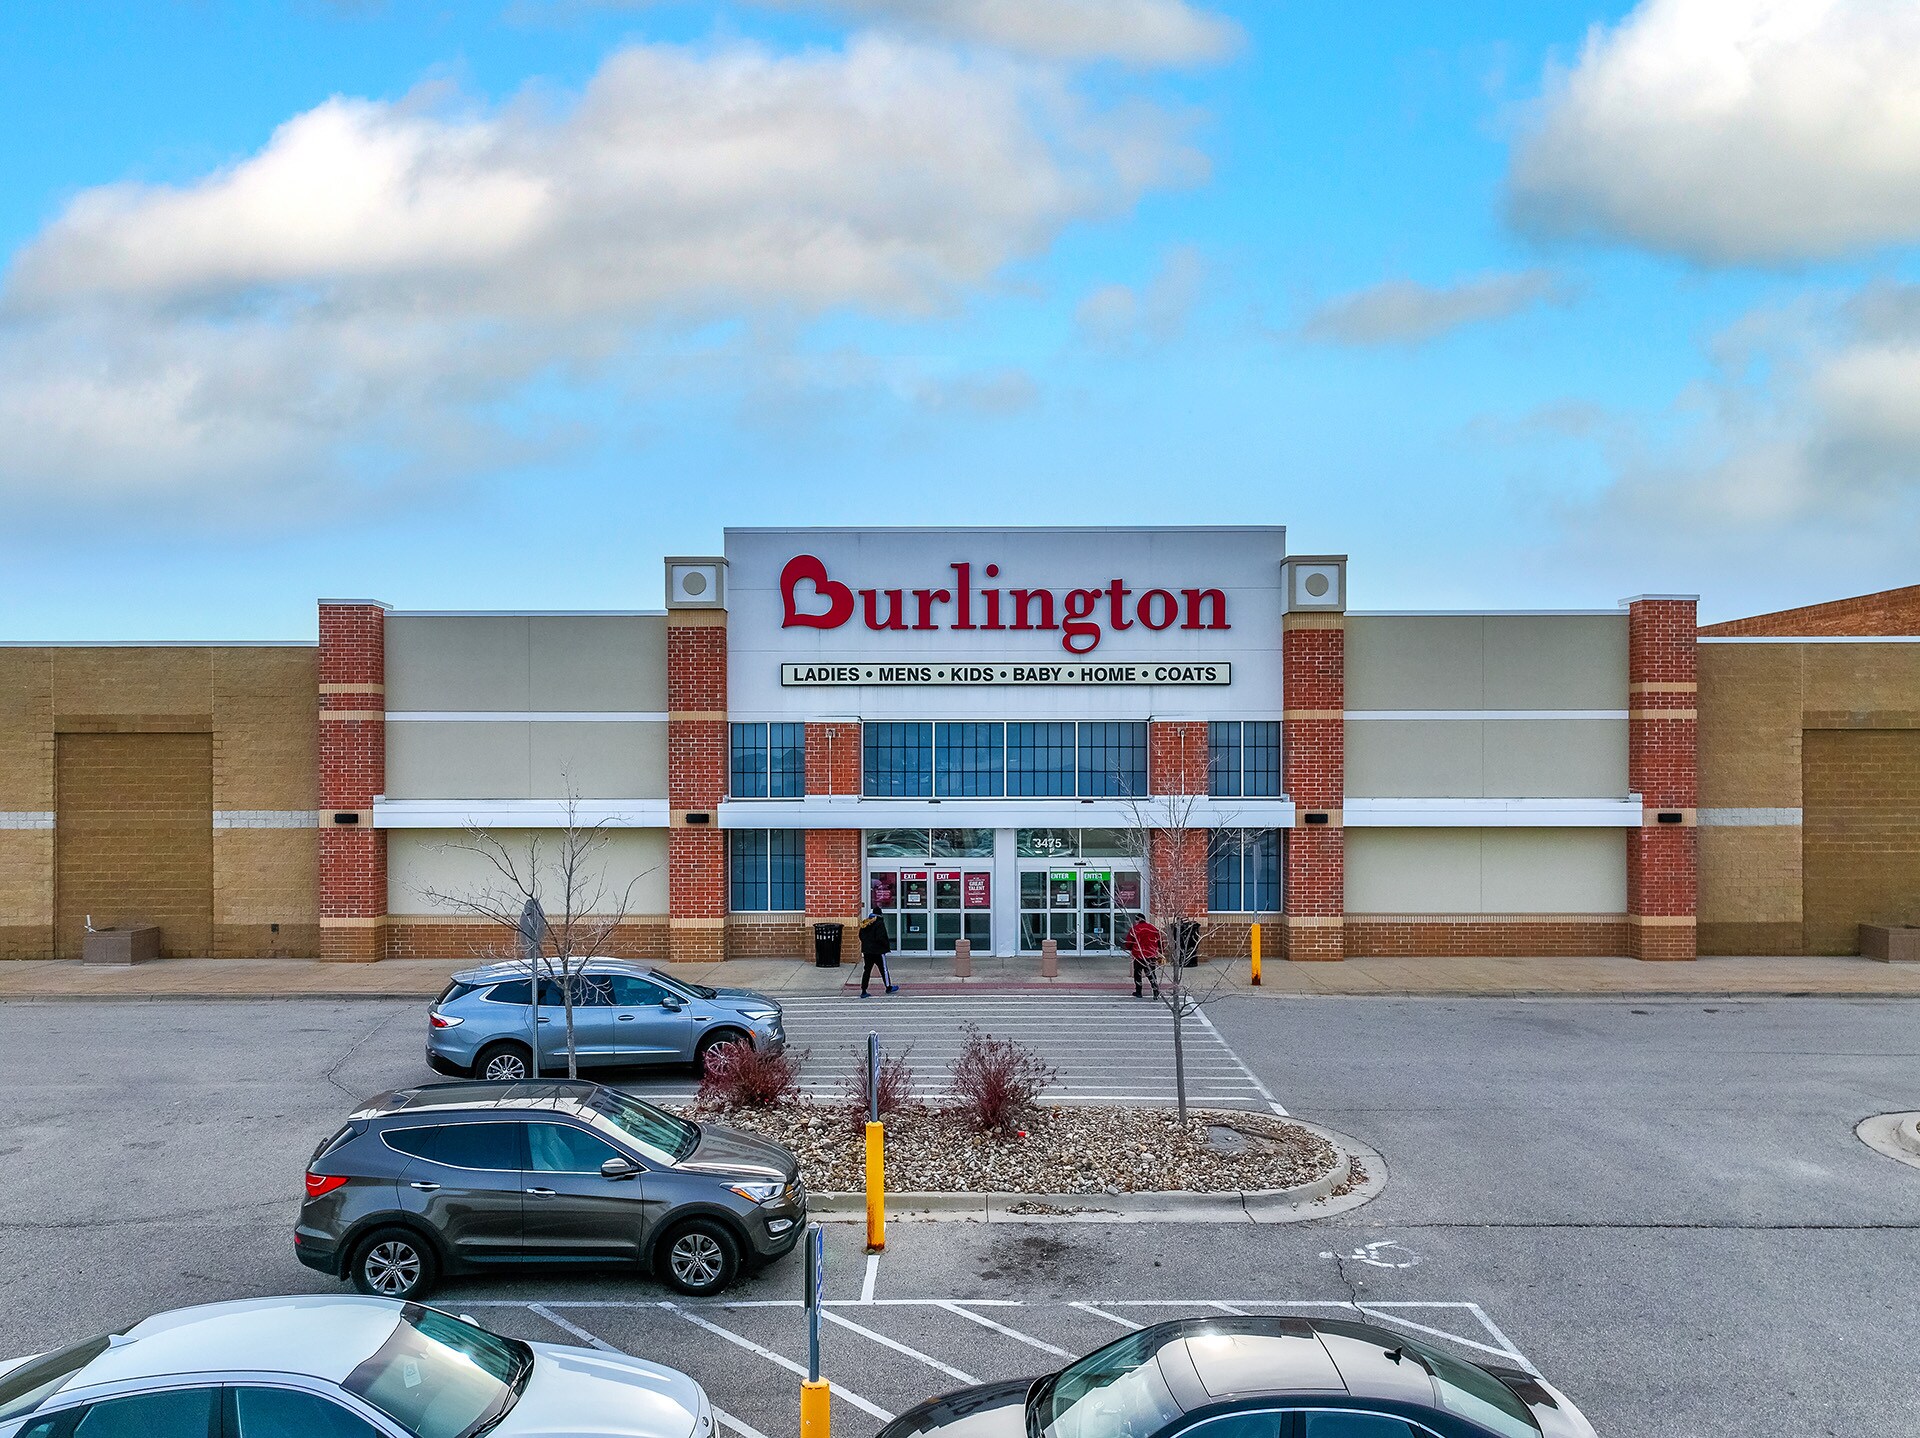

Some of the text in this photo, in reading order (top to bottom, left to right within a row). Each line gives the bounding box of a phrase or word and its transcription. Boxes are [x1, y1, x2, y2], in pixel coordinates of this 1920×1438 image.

[780, 554, 1231, 654] Burlington
[793, 667, 1217, 682] LADIES MENS KIDS BABY HOME COATS
[1033, 838, 1062, 849] 3475
